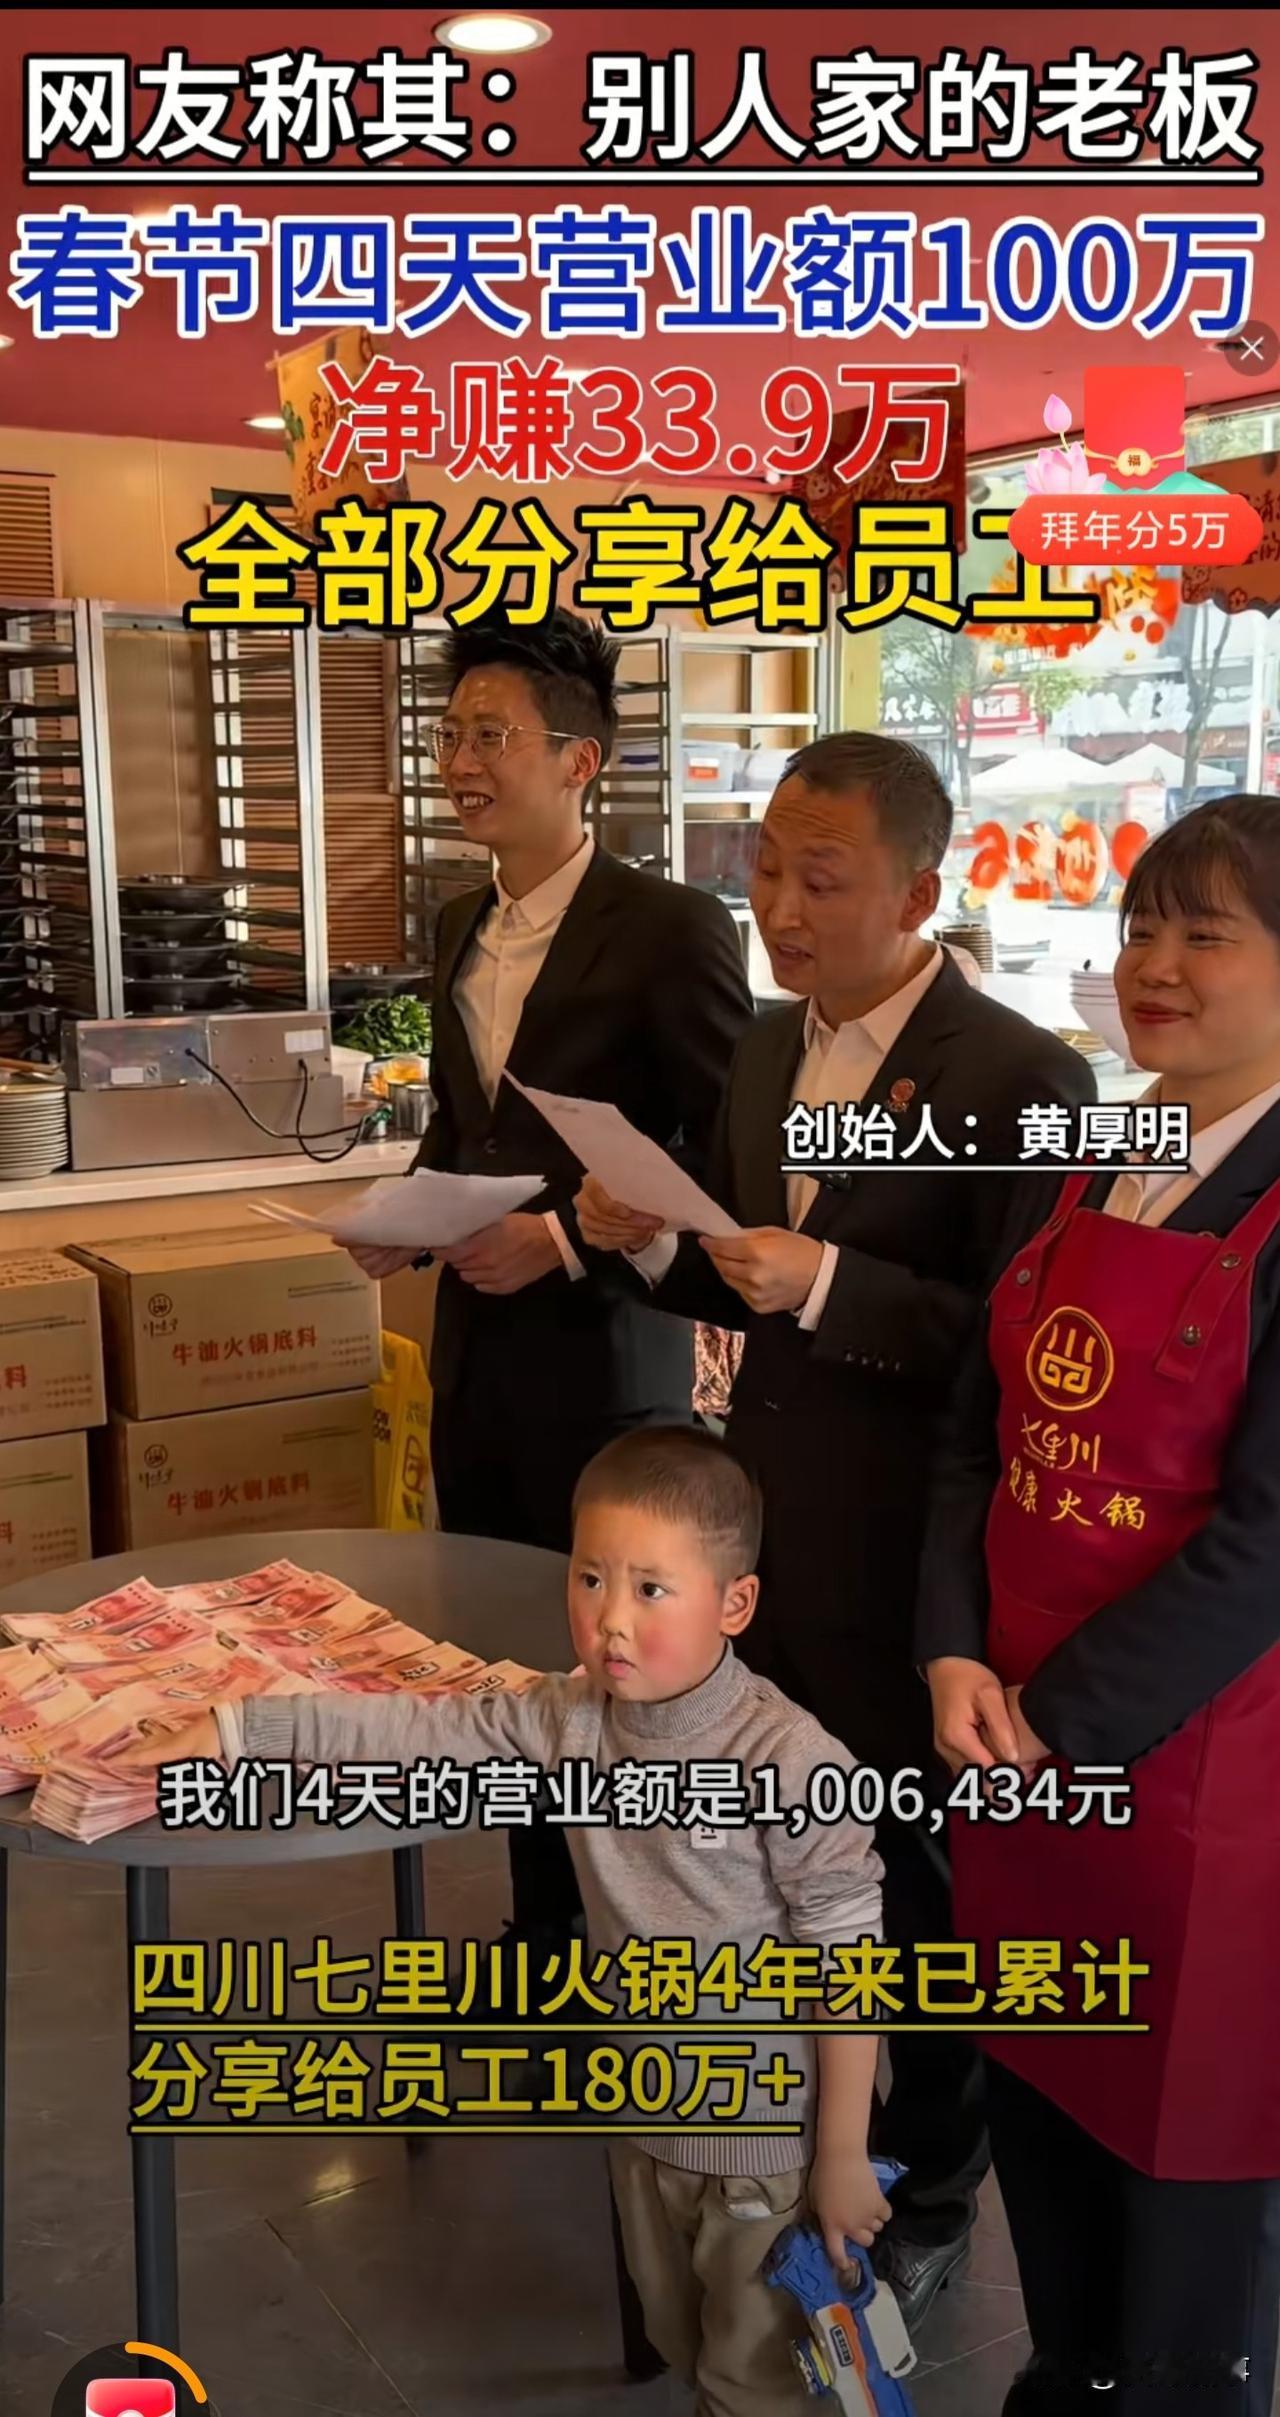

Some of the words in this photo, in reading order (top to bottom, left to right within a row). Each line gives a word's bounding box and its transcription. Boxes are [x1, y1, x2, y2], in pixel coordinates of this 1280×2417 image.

[172, 1325, 317, 1366] 牛油火锅底料
[167, 1471, 310, 1516] 牛油火锅底料
